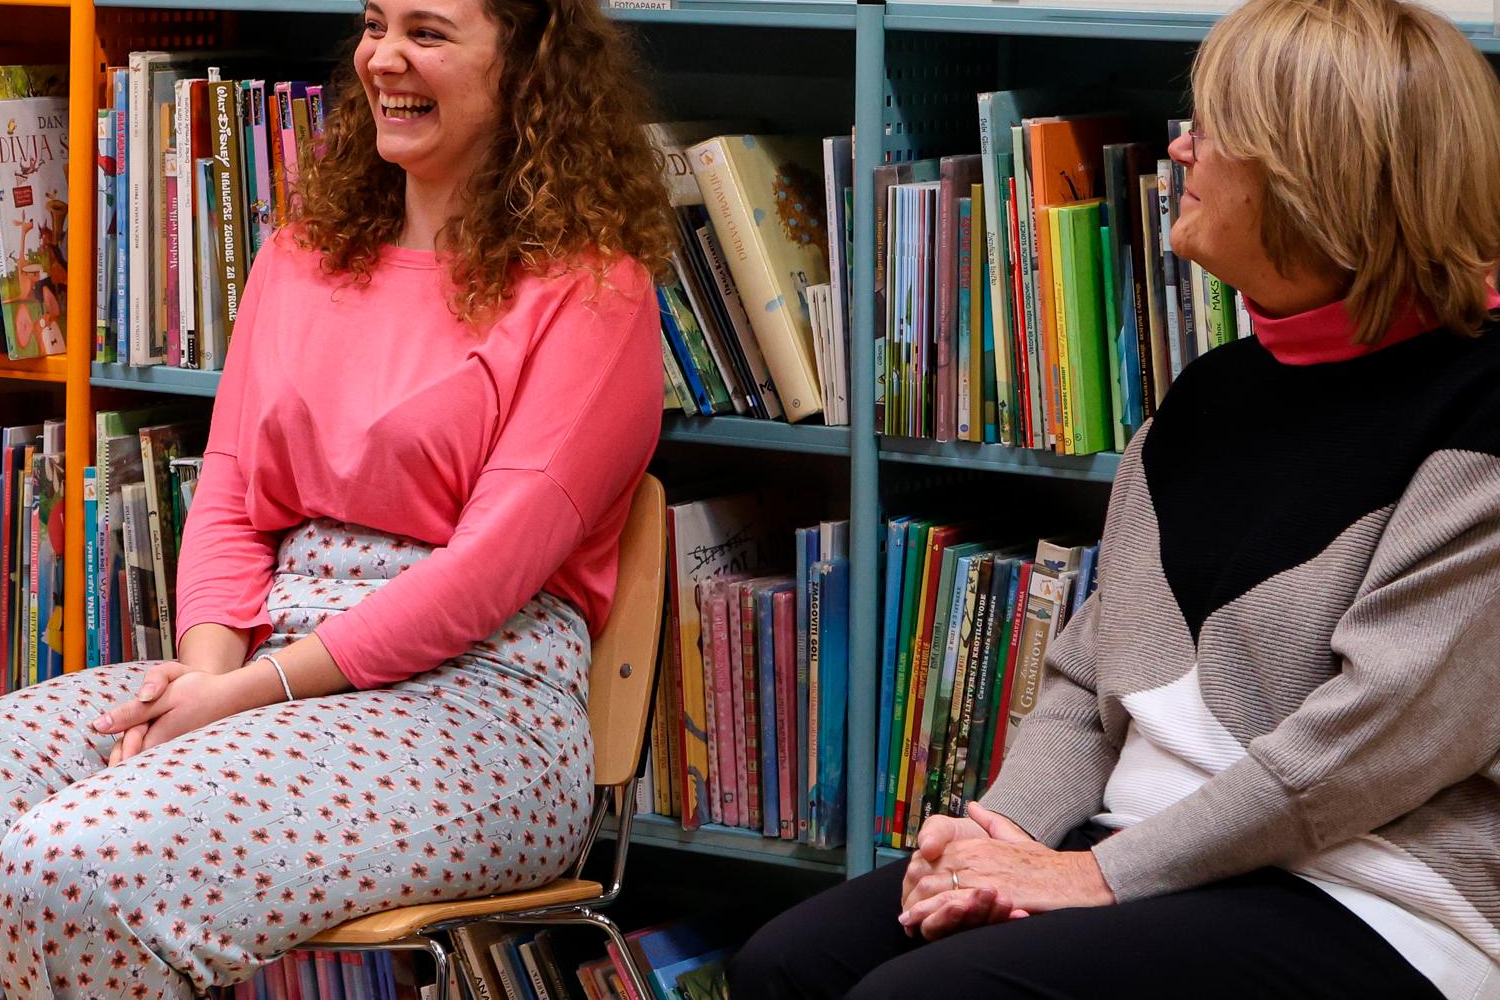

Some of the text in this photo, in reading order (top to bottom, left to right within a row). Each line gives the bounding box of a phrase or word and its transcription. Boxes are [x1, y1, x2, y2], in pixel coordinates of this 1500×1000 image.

[38, 115, 63, 129] DAN
[169, 232, 178, 269] Medved
[224, 224, 235, 262] ZGODBE
[1021, 247, 1029, 275] MAVRIČNI
[226, 266, 236, 279] ZA
[227, 283, 237, 321] OTROKE
[1210, 280, 1221, 311] MAKS
[811, 581, 819, 635] ZMAGOVITI
[962, 713, 970, 736] ZMAJ
[966, 670, 975, 712] LINTVERN
[973, 618, 982, 657] KROTILCI
